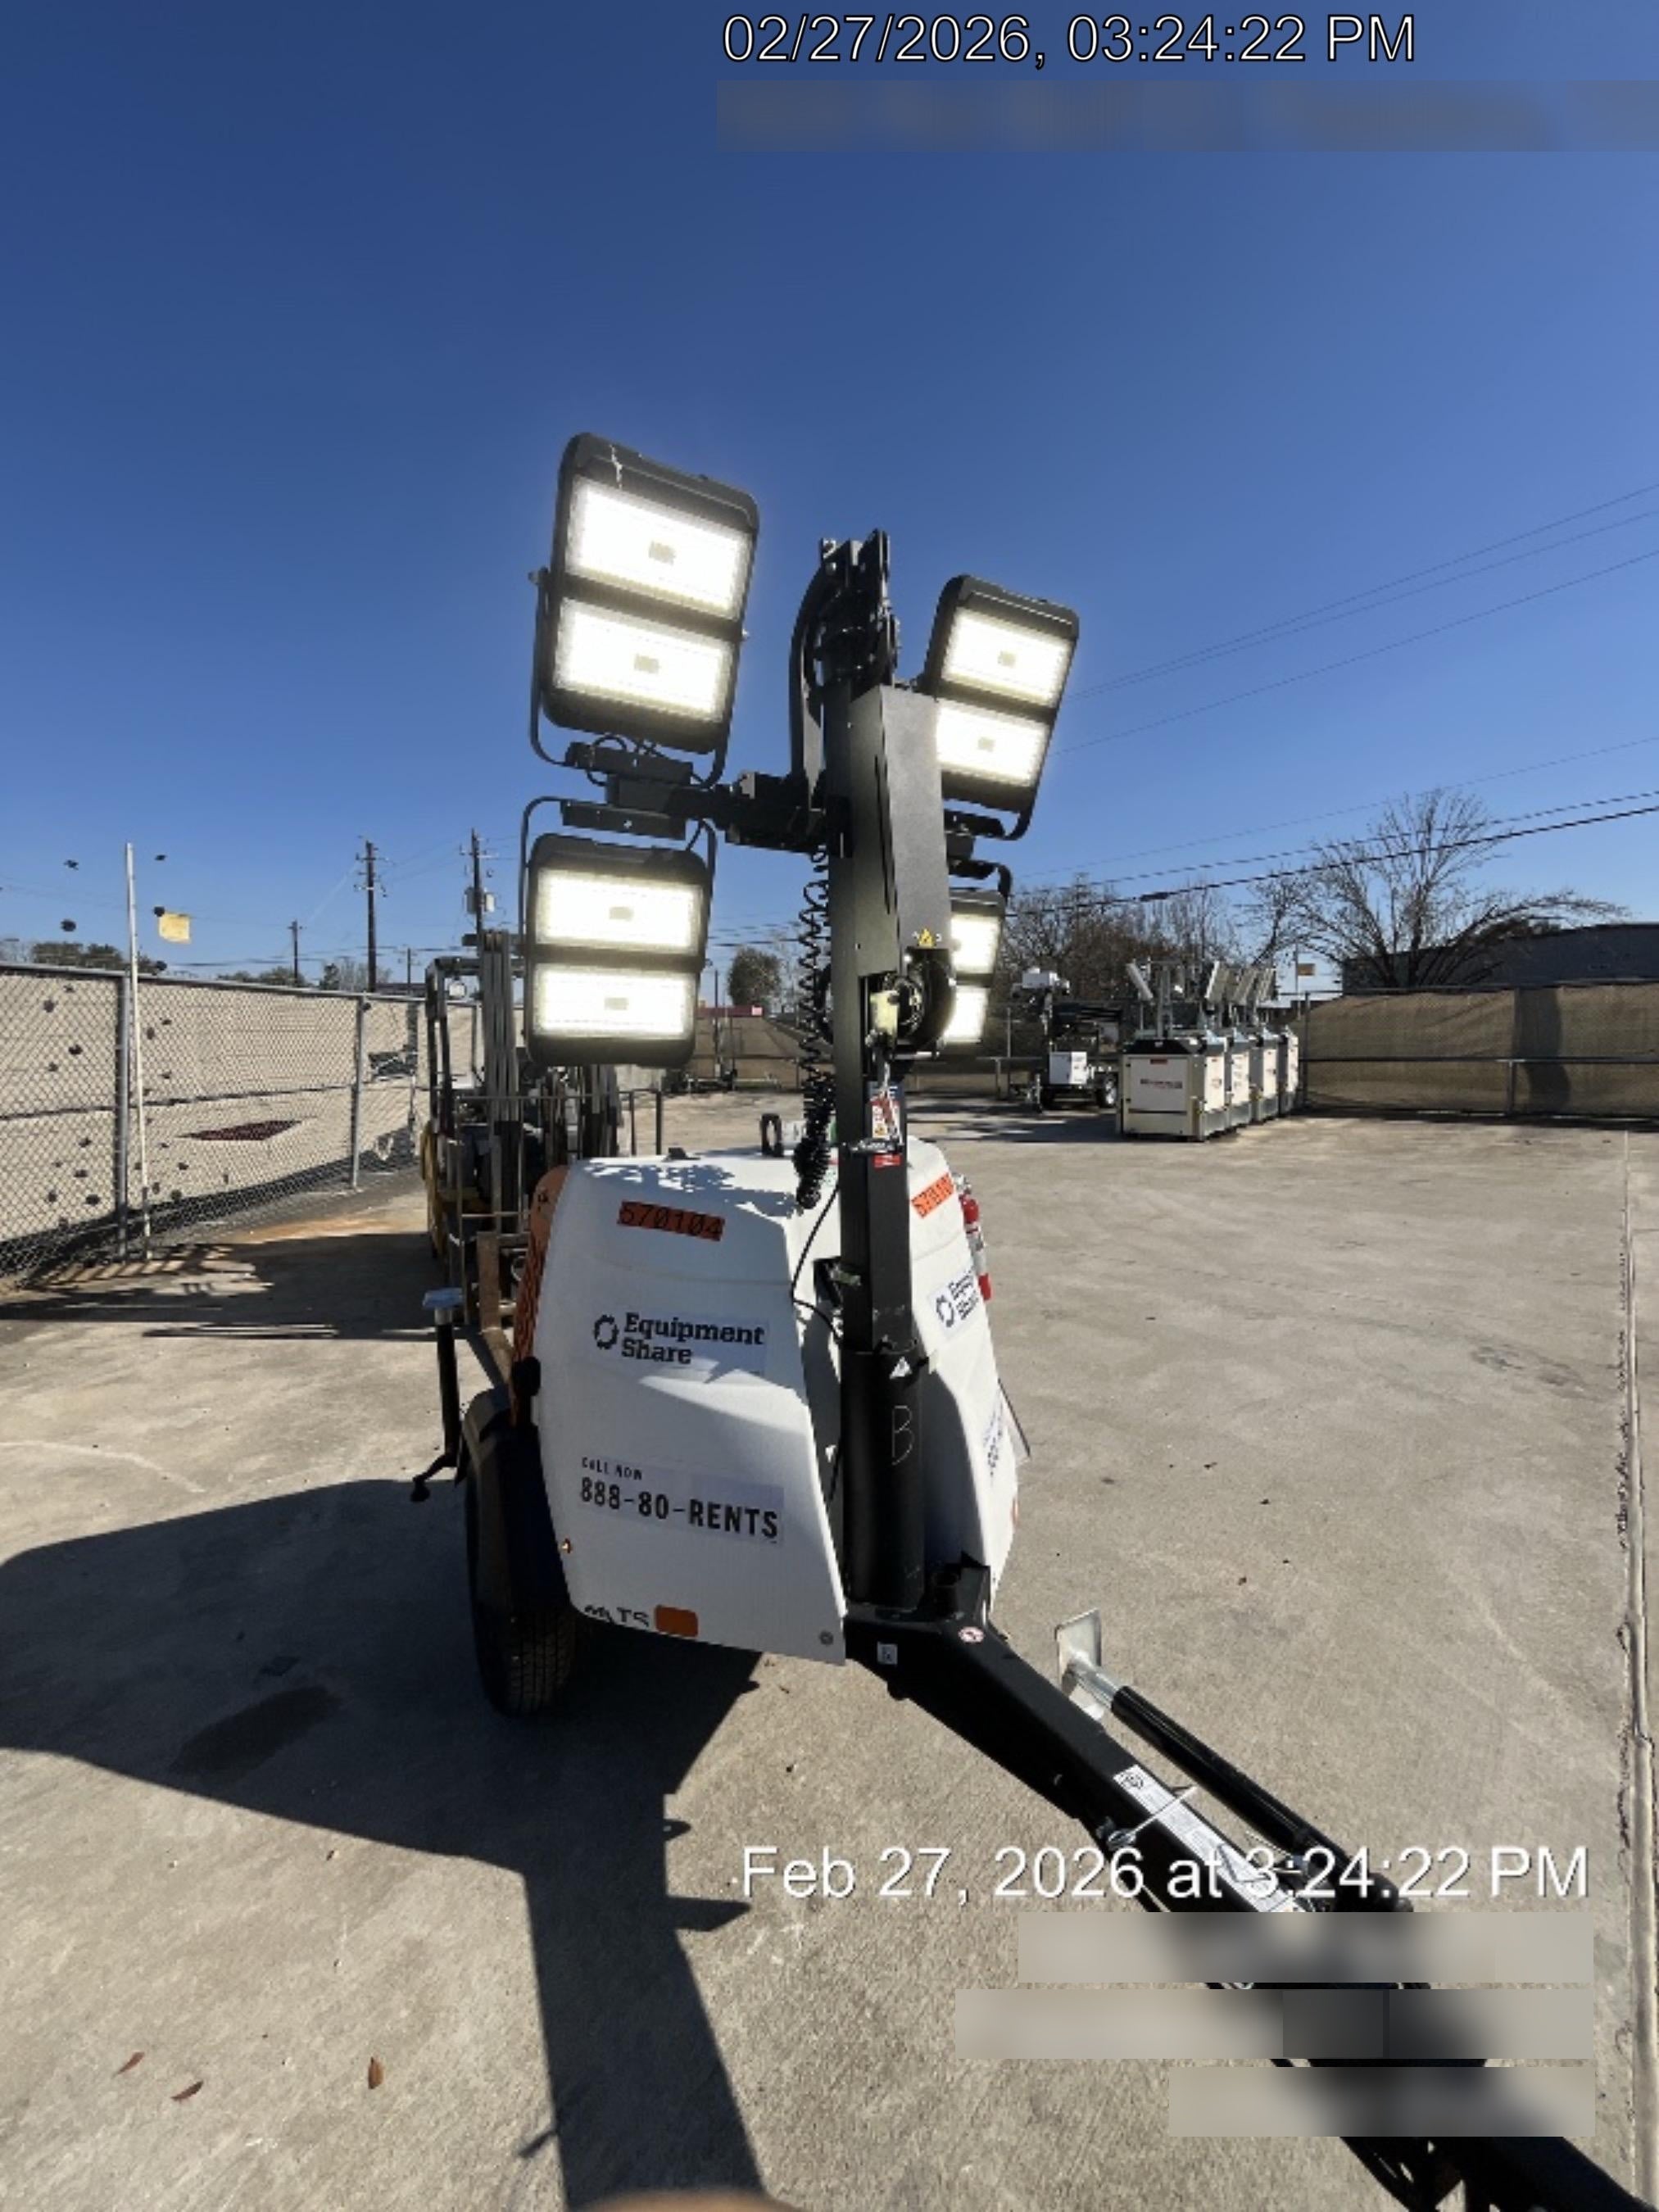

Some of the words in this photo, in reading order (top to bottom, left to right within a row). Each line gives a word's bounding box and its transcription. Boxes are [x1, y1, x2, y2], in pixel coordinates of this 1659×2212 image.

[623, 1312, 765, 1345] Equipment
[621, 1336, 693, 1365] Share
[580, 1476, 778, 1539] 888-80-RENTS
